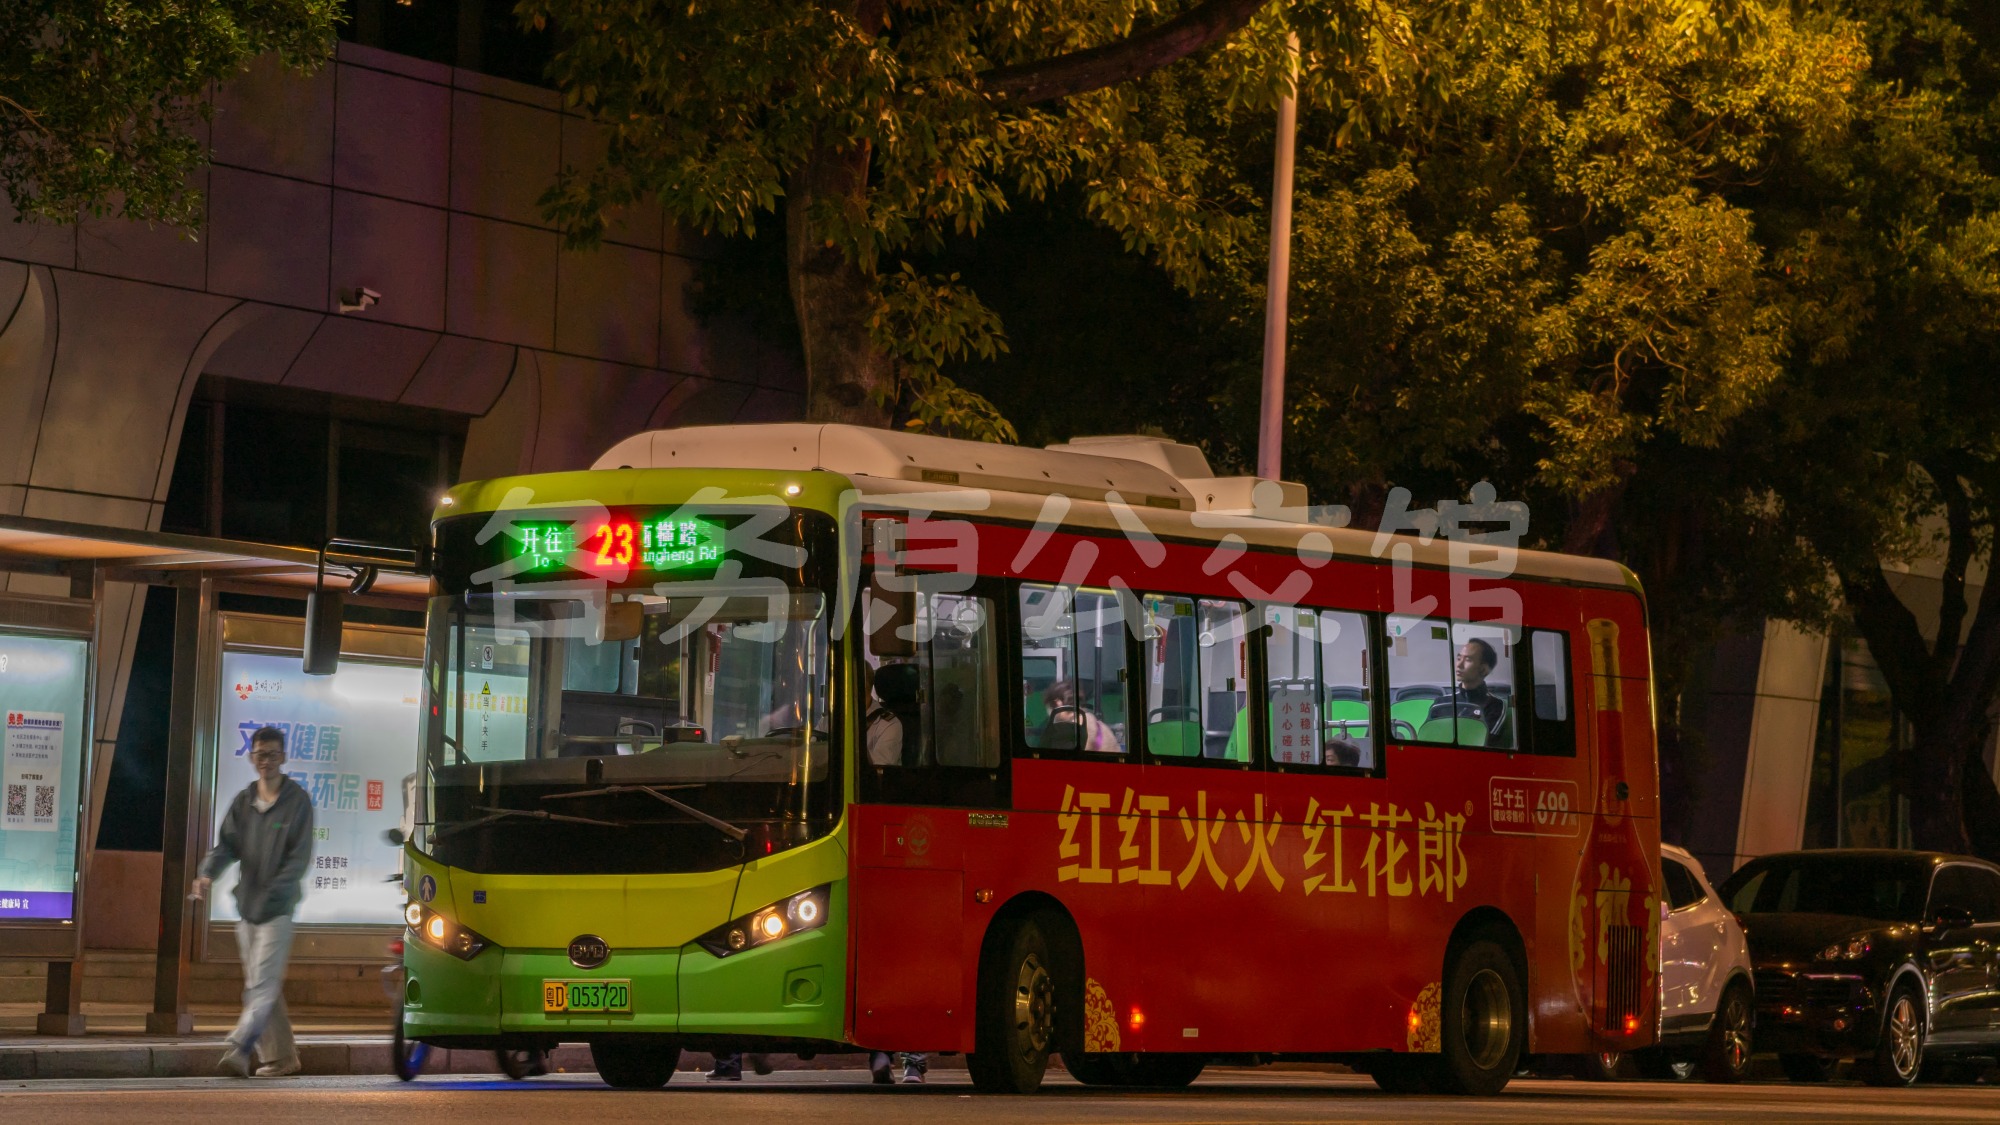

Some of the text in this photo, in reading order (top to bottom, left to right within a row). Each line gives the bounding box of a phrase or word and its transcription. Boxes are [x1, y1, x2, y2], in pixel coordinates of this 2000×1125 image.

[520, 528, 563, 553] 开往
[595, 524, 634, 565] 23
[699, 546, 717, 560] Rd
[1300, 702, 1311, 763] 站稳扶好
[1493, 788, 1525, 809] 红十五
[1057, 784, 1468, 902] 红红火火 红花郎
[316, 856, 348, 869] 拒食野味
[315, 876, 347, 889] 保护自然
[572, 945, 604, 958] BYD
